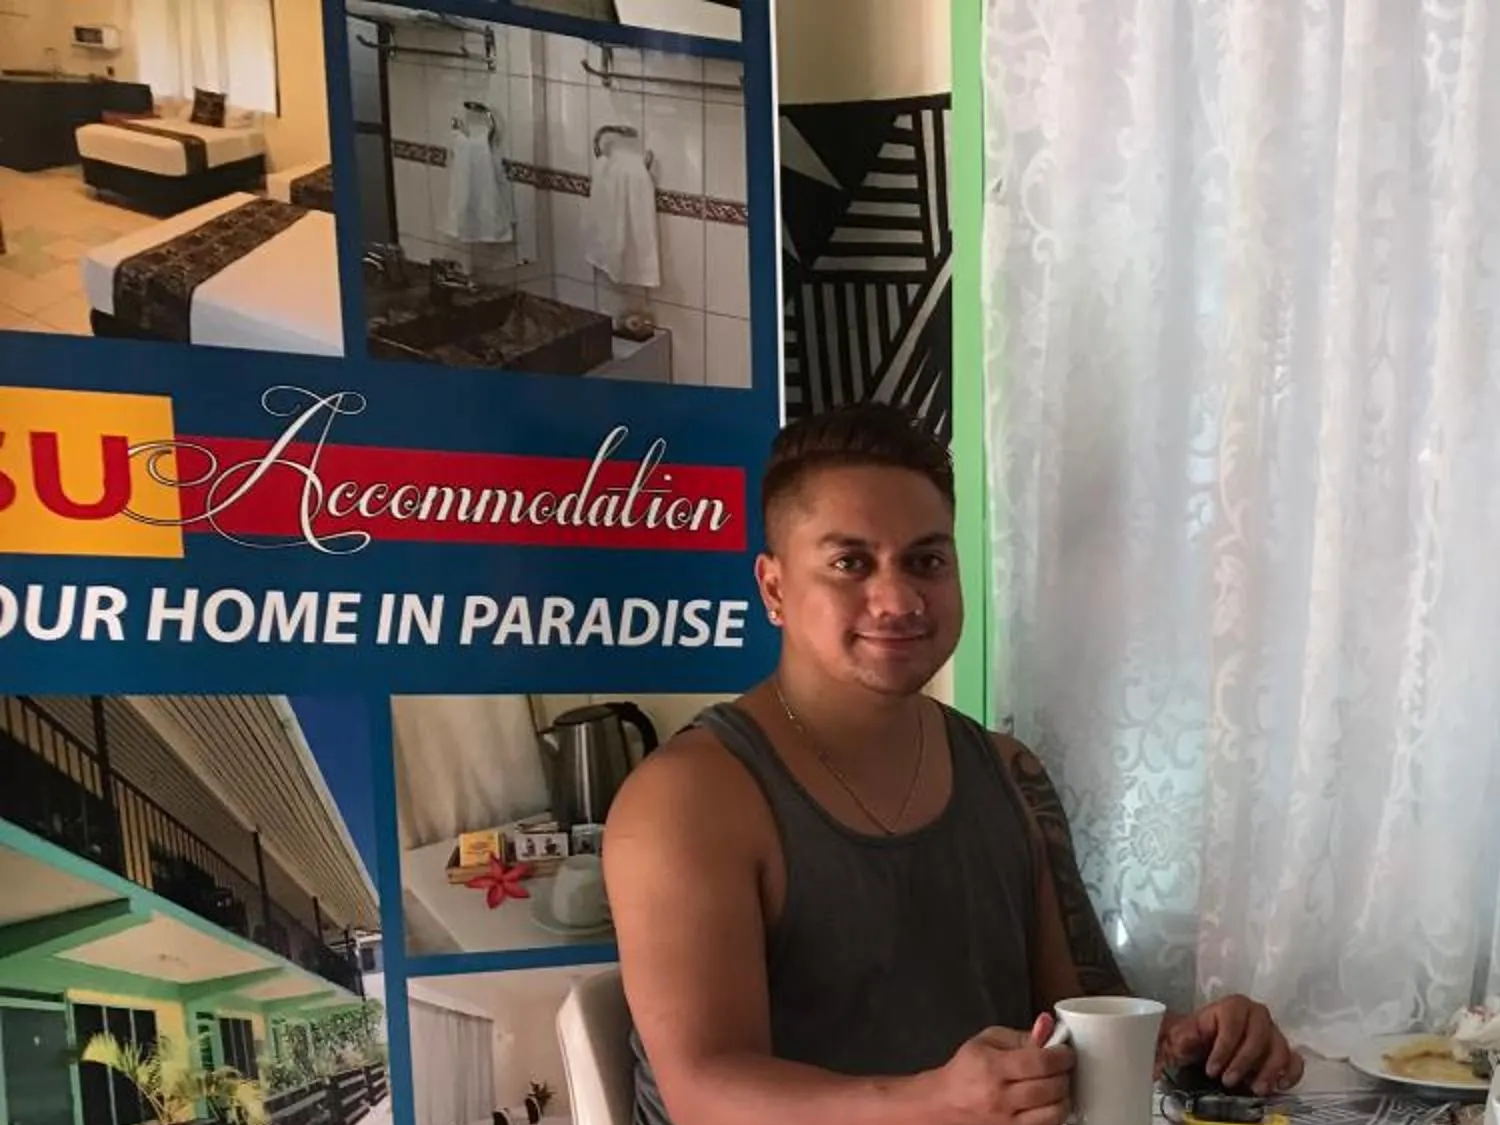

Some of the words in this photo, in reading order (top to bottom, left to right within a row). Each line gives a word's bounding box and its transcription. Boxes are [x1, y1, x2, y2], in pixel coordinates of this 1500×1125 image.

[120, 385, 731, 554] Accommodation
[147, 587, 361, 645] HOME
[376, 592, 445, 645] IN
[458, 595, 749, 648] PARADISE
